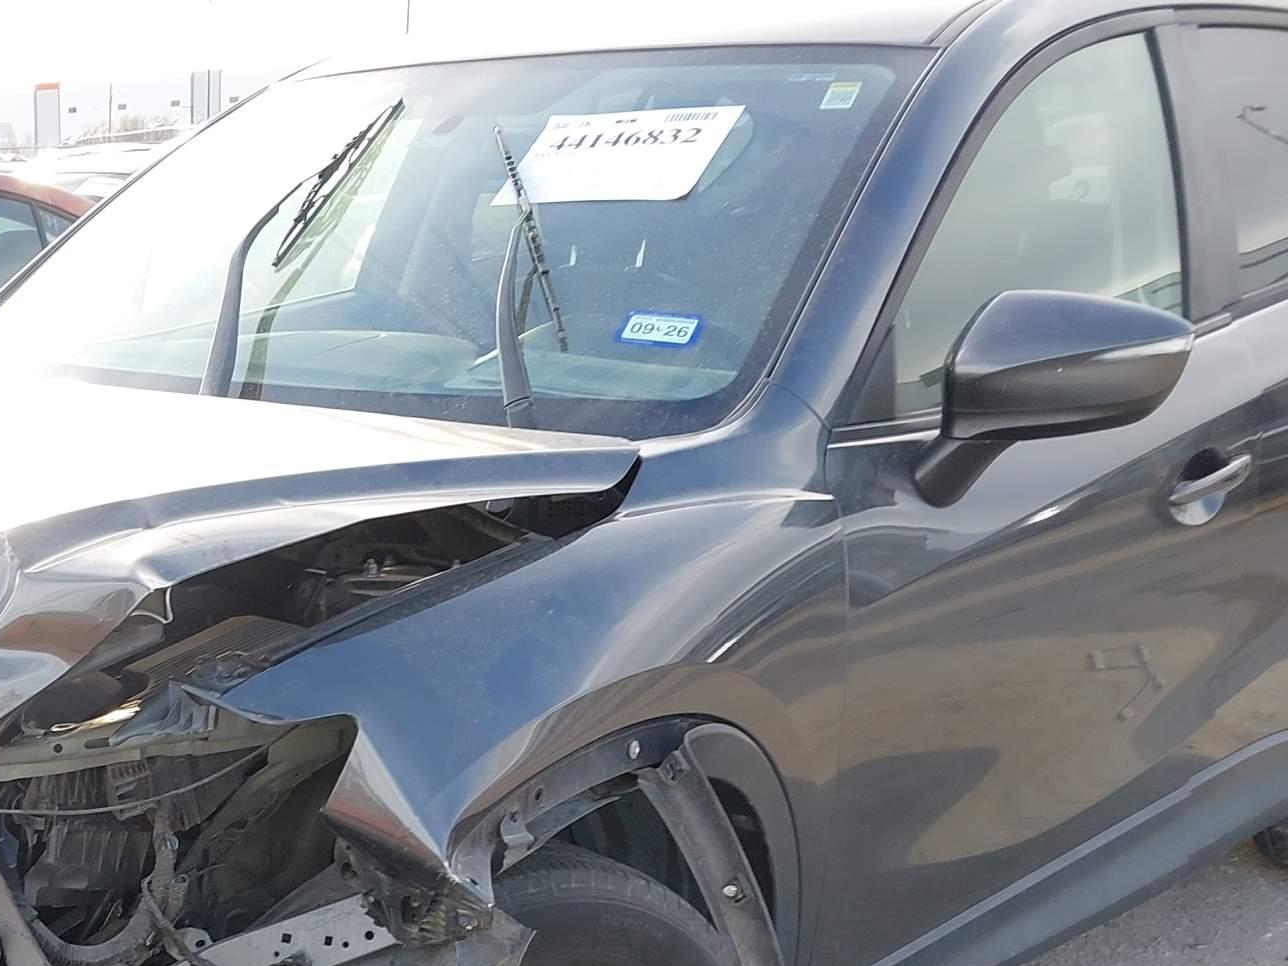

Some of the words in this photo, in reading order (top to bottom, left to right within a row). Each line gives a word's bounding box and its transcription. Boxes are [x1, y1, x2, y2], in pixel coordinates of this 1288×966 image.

[550, 127, 703, 151] 44146832
[630, 322, 655, 335] 09
[663, 325, 690, 338] 26
